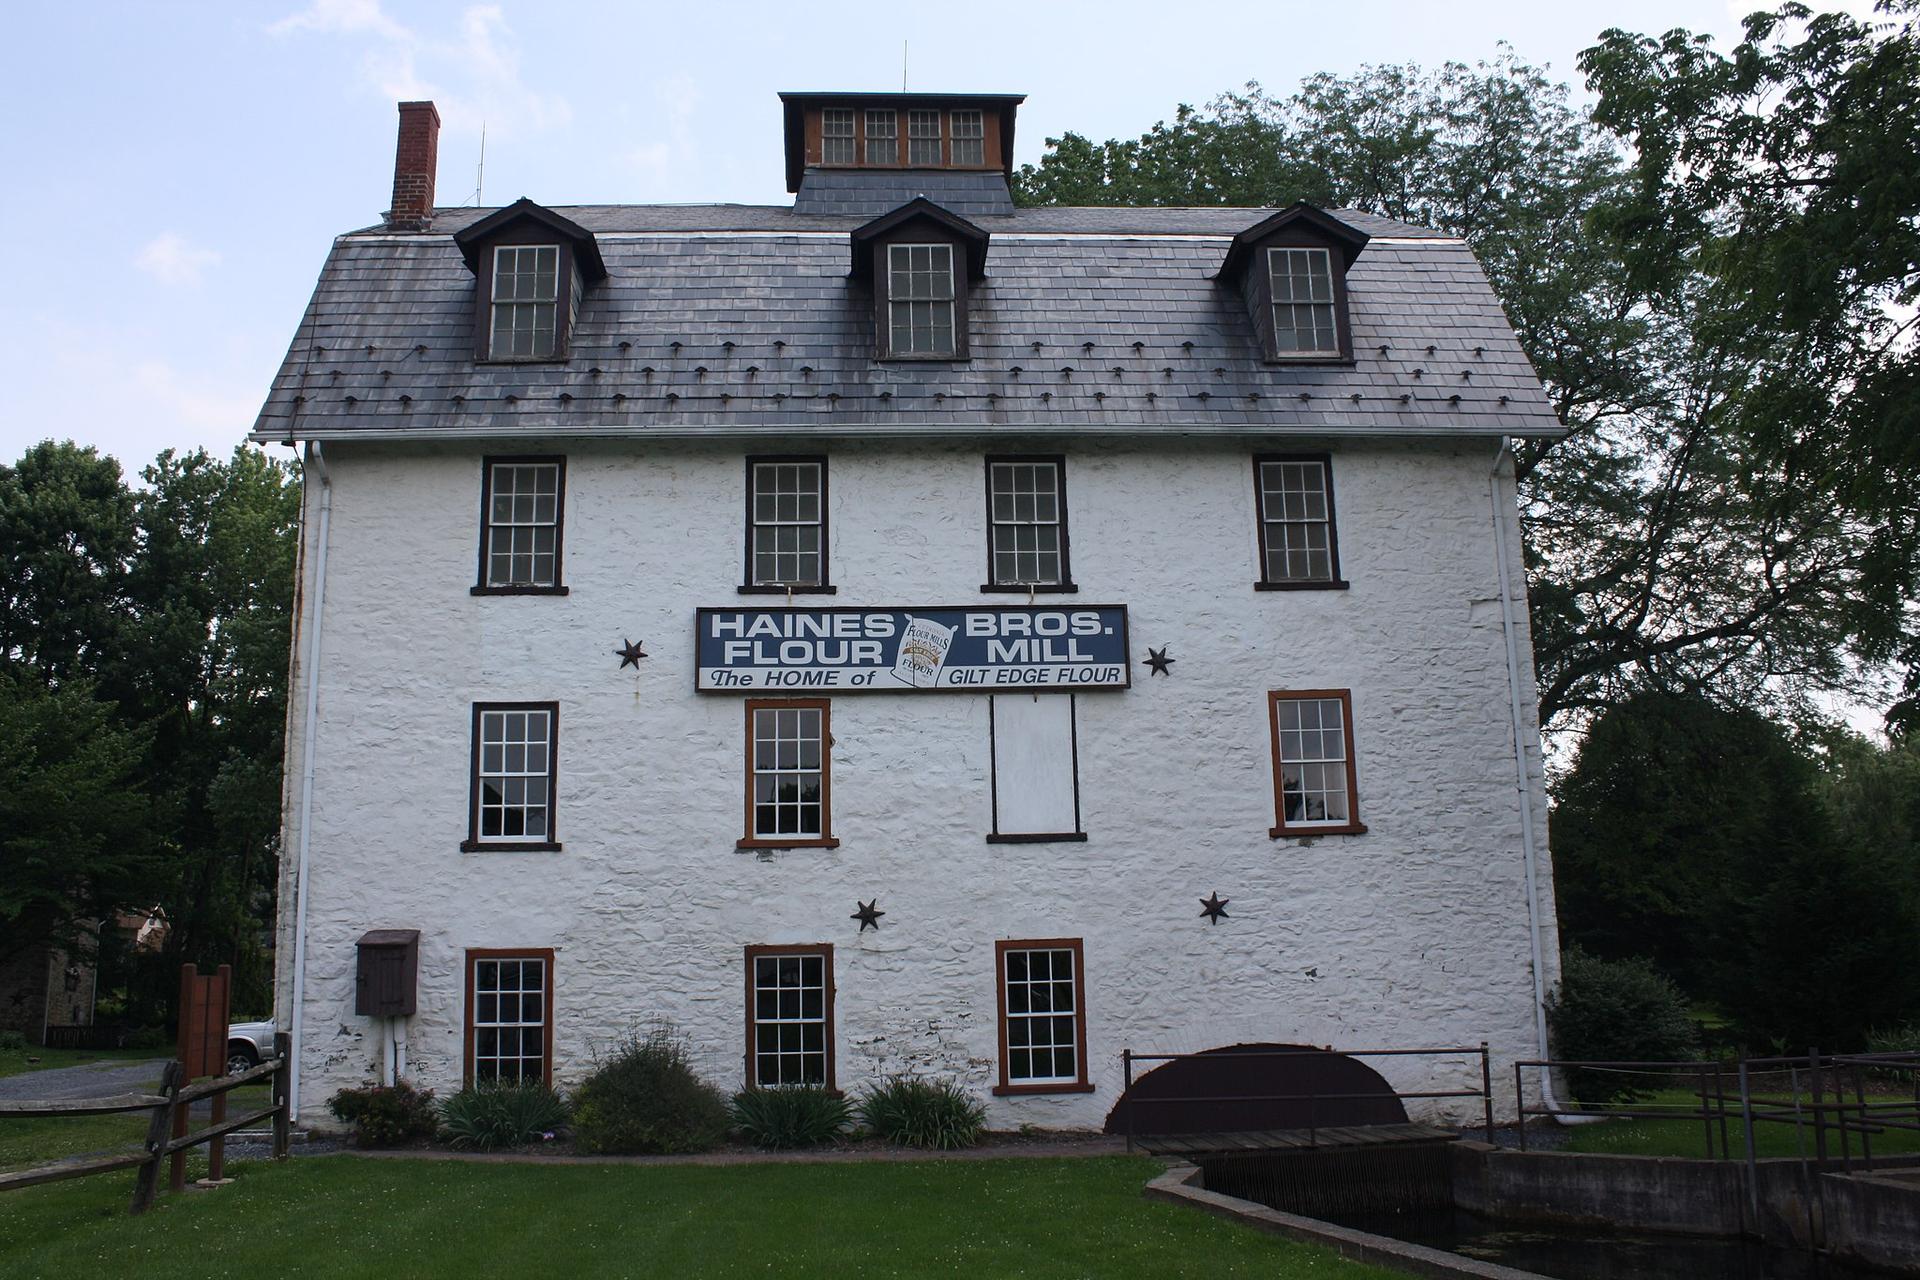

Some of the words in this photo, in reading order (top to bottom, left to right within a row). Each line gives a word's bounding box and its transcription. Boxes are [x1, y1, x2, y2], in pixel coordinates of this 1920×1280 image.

[711, 613, 896, 638] HAINES
[965, 611, 1113, 637] BROS.
[907, 625, 930, 640] FLOUR
[929, 633, 949, 650] MILLS
[724, 640, 882, 665] FLOUR
[987, 639, 1094, 663] MILL
[710, 669, 753, 686] The
[764, 670, 840, 686] HOME
[850, 670, 876, 686] of
[949, 668, 991, 684] GILT
[995, 668, 1050, 683] EDGE
[1057, 667, 1120, 683] FLOUR
[902, 658, 934, 676] FLOUR
